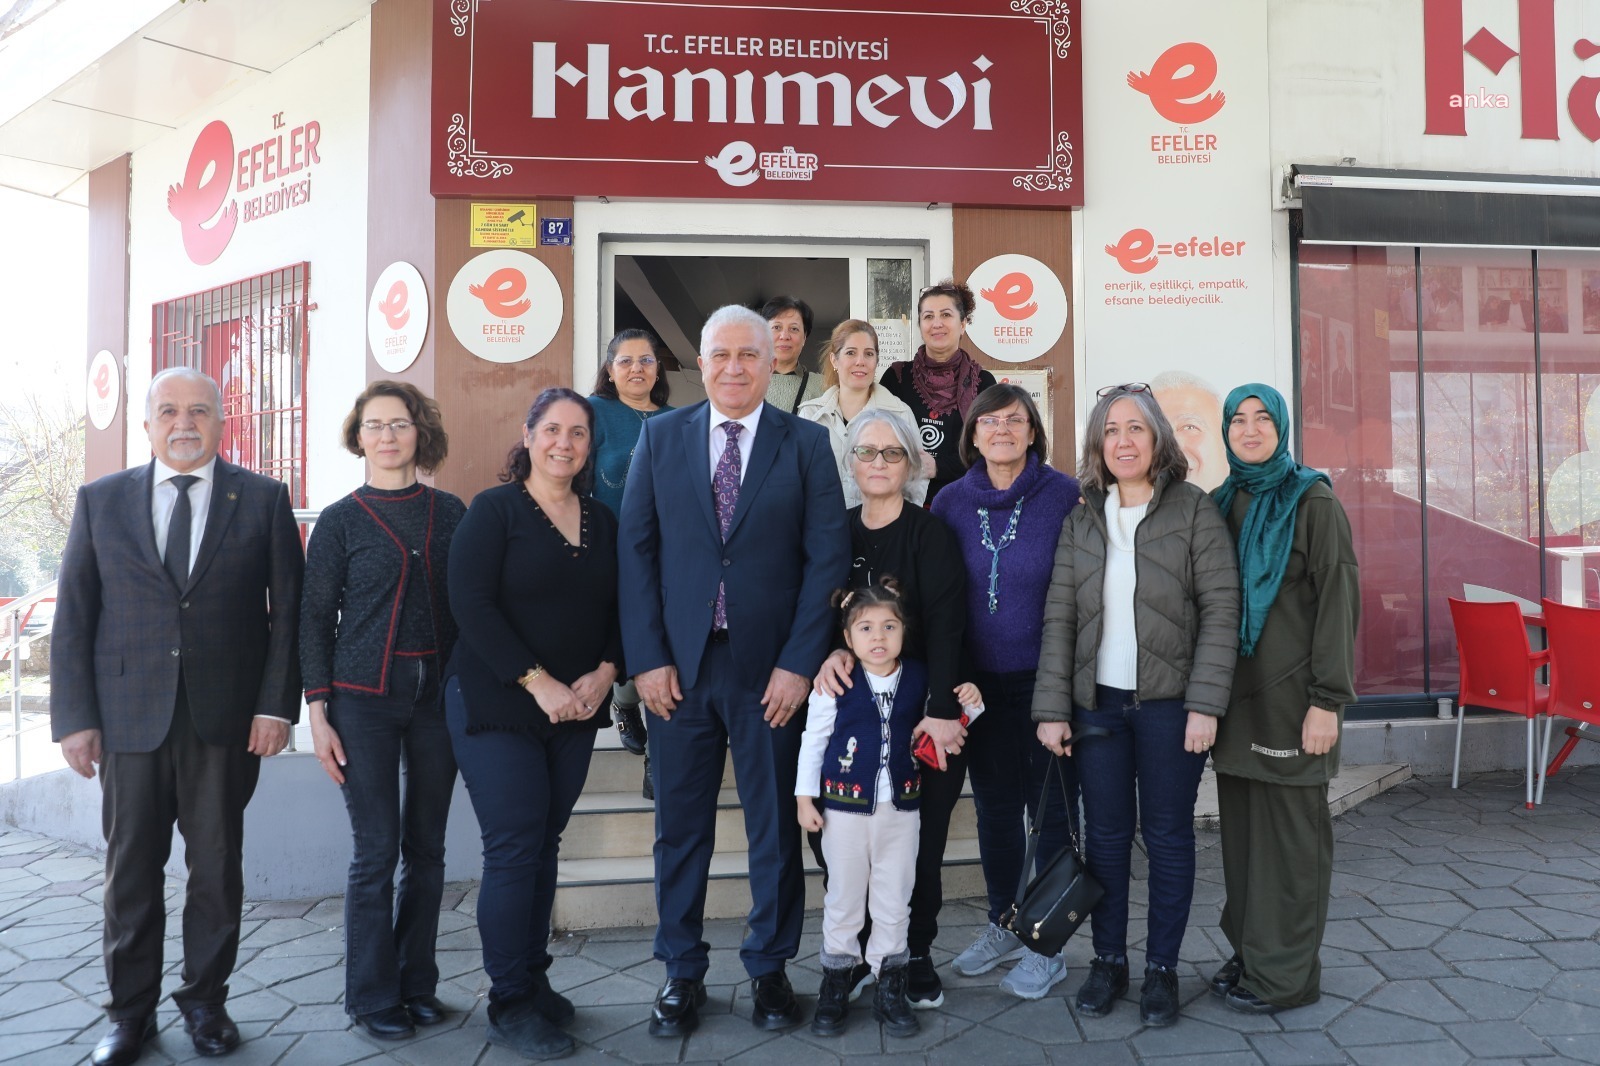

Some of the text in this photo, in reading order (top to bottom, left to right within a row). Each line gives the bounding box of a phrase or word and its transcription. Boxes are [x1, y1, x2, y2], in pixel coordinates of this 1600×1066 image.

[644, 34, 888, 61] T.C. EFELER BELEDİYESİ
[532, 40, 993, 131] Hanımevi
[1151, 134, 1217, 151] EFELER
[237, 120, 321, 193] EFELER
[761, 154, 817, 170] EFELER
[1158, 152, 1211, 164] BELEDİYESİ
[766, 169, 811, 179] BELEDİYESİ
[242, 172, 312, 223] BELEDİYESİ
[548, 222, 564, 234] 87
[1104, 278, 1248, 292] enerjik, eşitlikçi, empatik,
[1104, 294, 1223, 306] efsane belediyecilik.
[482, 324, 525, 335] EFELER
[994, 326, 1033, 337] EFELER
[486, 335, 521, 343] BELEDİYESİ
